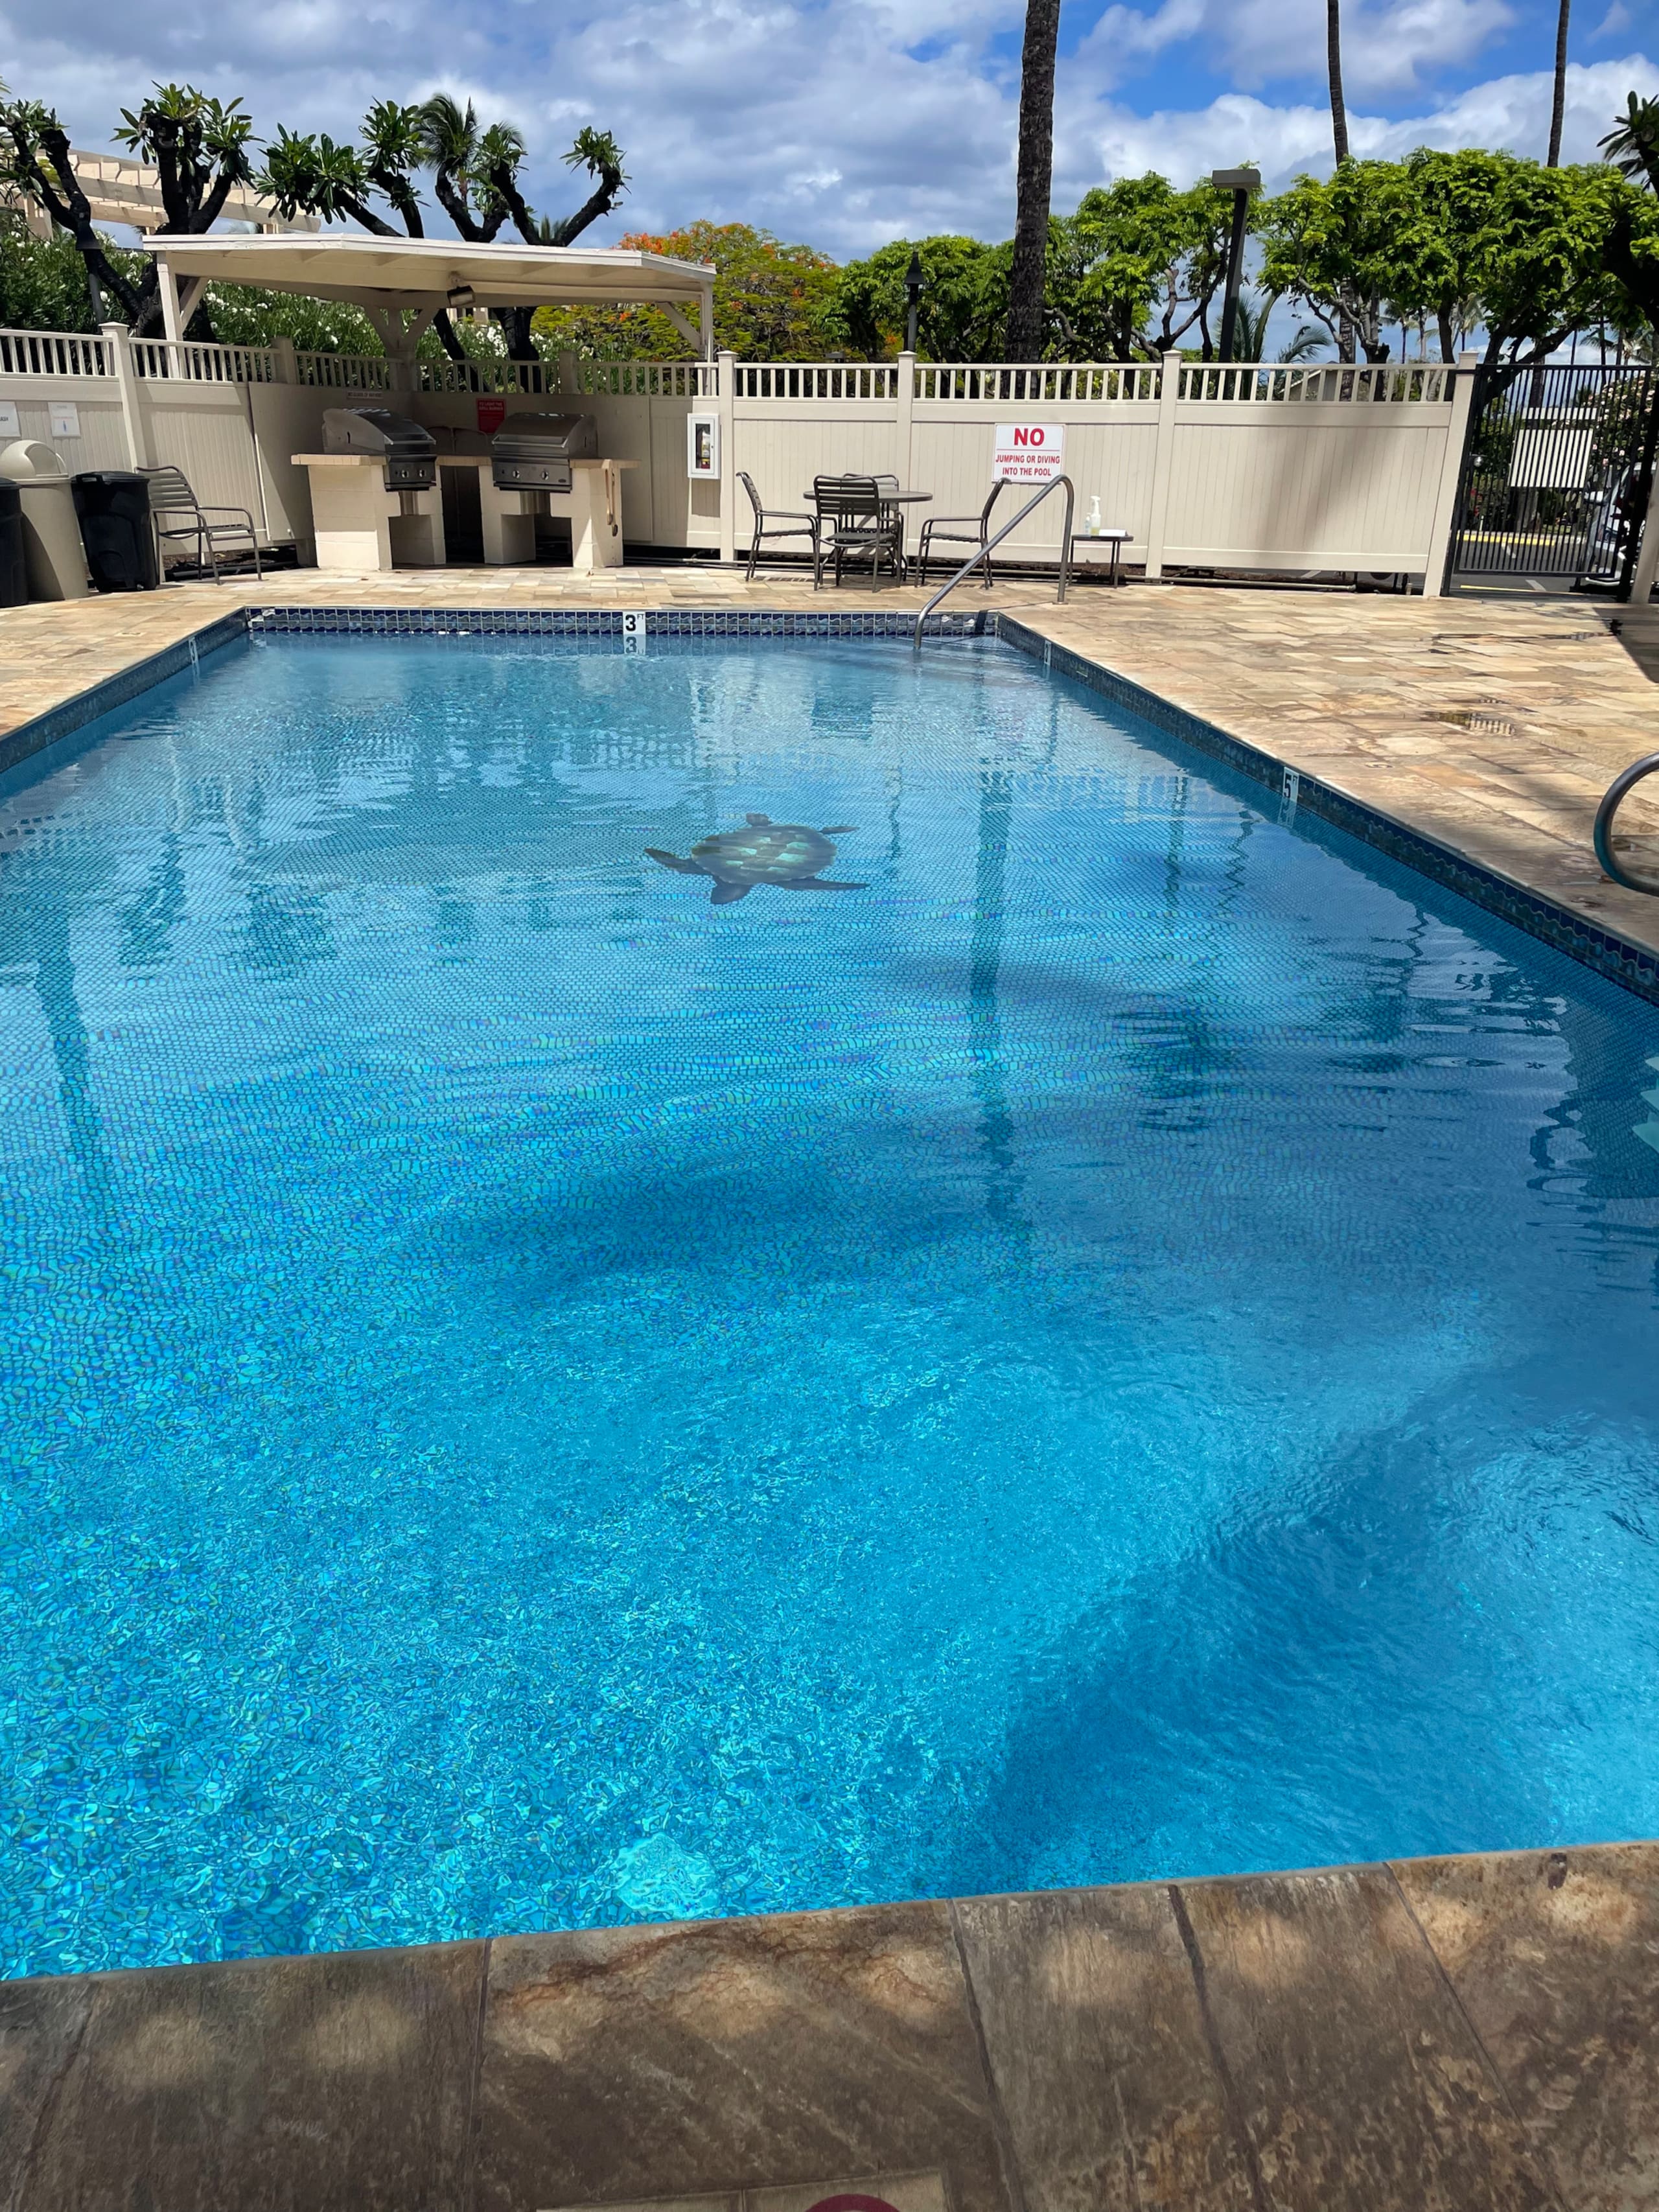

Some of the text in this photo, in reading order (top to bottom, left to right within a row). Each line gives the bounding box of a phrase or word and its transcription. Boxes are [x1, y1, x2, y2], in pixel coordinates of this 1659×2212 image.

[1014, 428, 1044, 446] NO
[995, 454, 1024, 463] JUMPING
[1038, 456, 1060, 464] DIVING
[1003, 467, 1051, 476] INTO THE POOL
[625, 614, 636, 631] 3
[1284, 773, 1292, 799] 5
